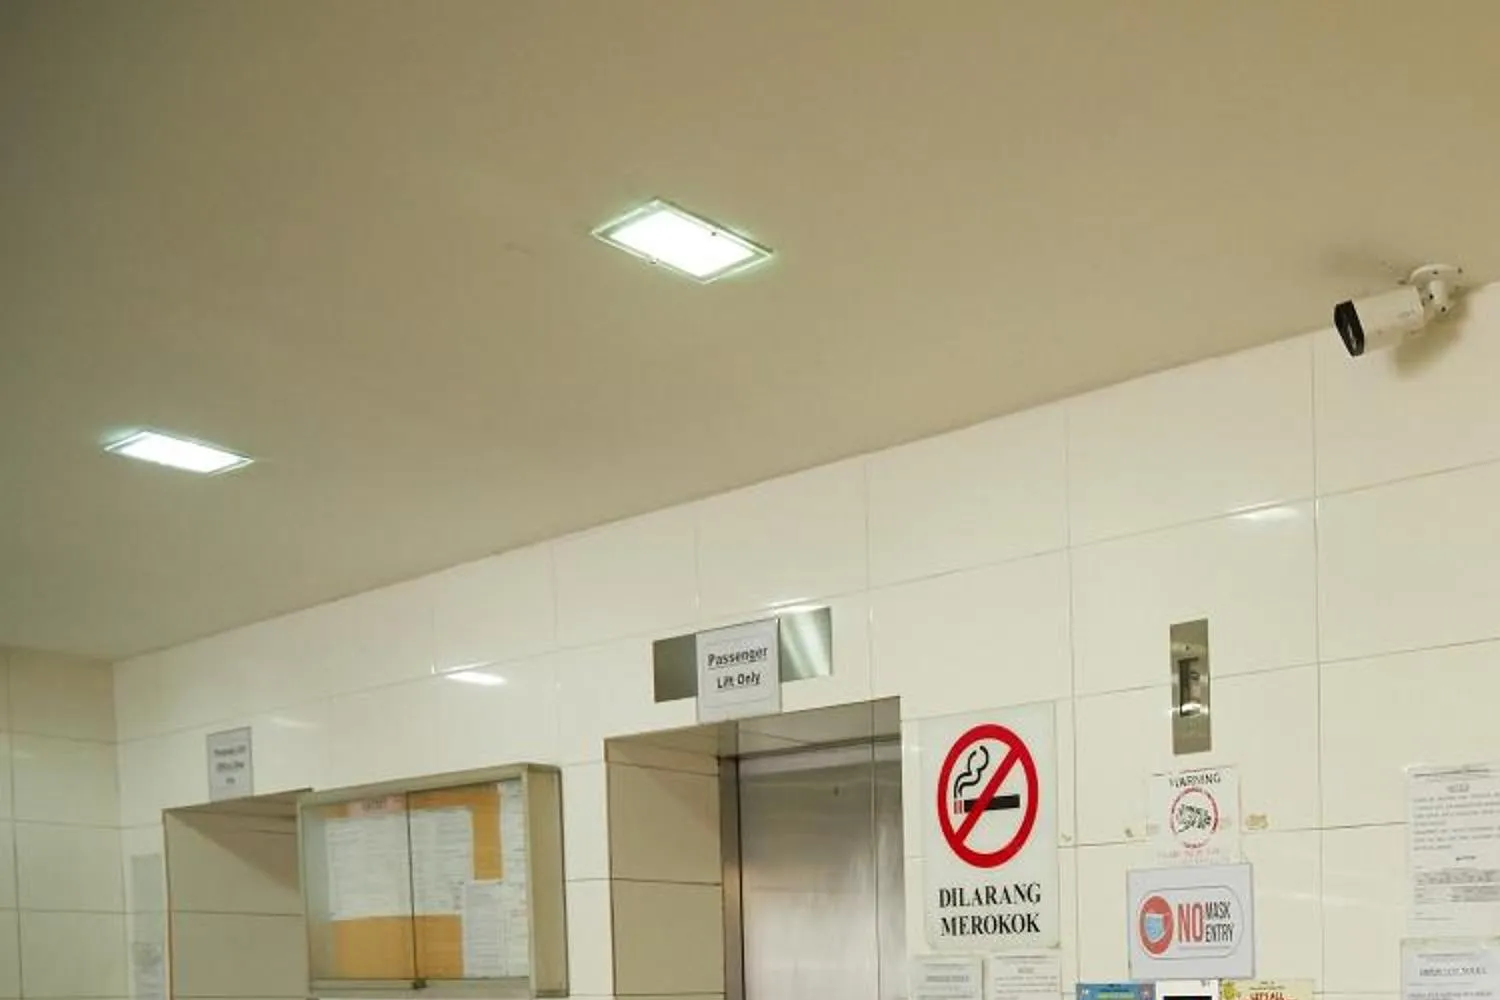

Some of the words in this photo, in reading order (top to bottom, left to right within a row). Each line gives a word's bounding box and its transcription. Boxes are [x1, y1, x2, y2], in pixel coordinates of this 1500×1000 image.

[707, 647, 769, 667] Passenger
[717, 676, 734, 689] Lift
[738, 672, 761, 687] Only
[1169, 772, 1221, 789] WARNING
[938, 882, 1041, 908] DILARANG
[940, 913, 1041, 936] MEROKOK
[1177, 903, 1204, 943] NO
[1205, 901, 1231, 920] MASK
[1205, 923, 1235, 943] ENTRY
